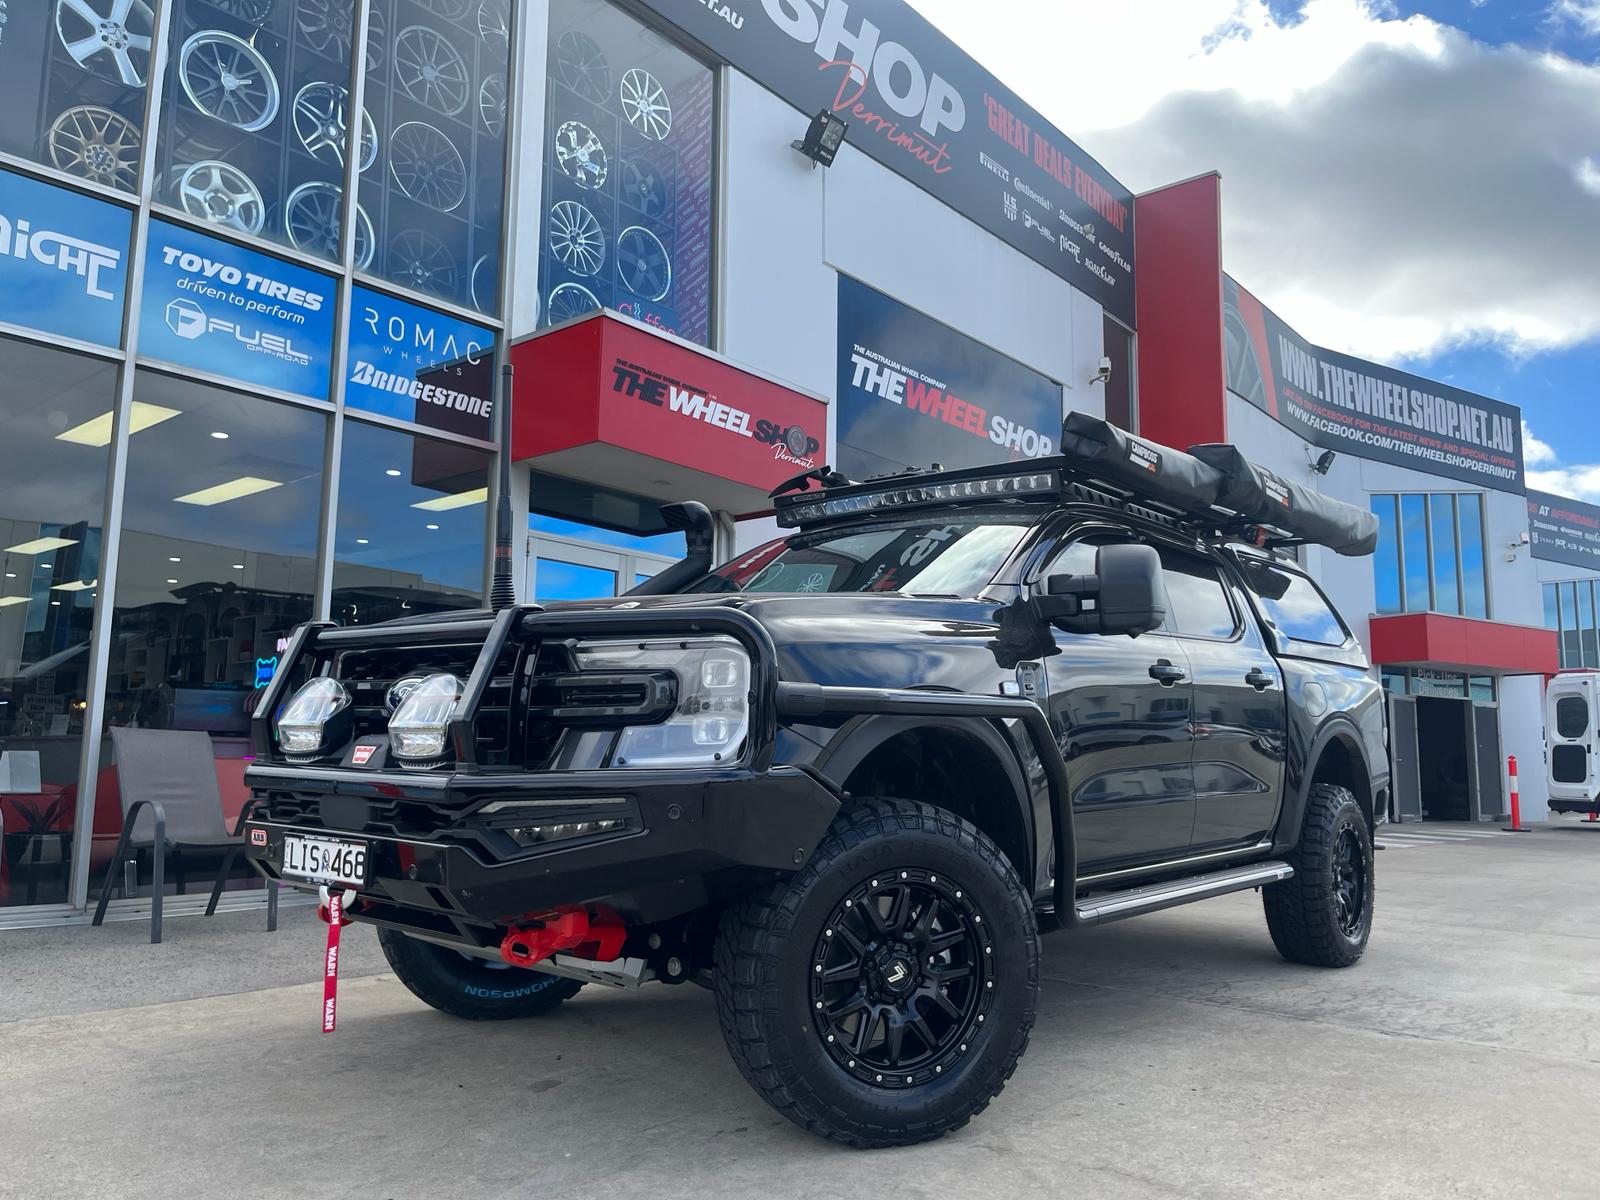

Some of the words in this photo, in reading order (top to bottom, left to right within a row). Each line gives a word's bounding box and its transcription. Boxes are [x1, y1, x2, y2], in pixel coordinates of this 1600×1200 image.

[761, 0, 967, 137] SHOP
[818, 60, 954, 175] Derrimut
[1034, 133, 1072, 190] DEALS
[162, 246, 241, 286] TOYO
[245, 272, 324, 312] TIRES
[176, 276, 229, 306] driven
[228, 290, 246, 307] to
[246, 297, 306, 326] perform
[207, 317, 309, 360] FUEL
[364, 306, 482, 367] ROMAC
[382, 344, 463, 377] WHEELS
[350, 360, 493, 419] BRIDGESTONE
[853, 343, 866, 355] THE
[865, 348, 902, 371] AUSTRALIAN
[901, 364, 920, 380] WHEEL
[919, 374, 948, 391] COMPANY
[1278, 333, 1515, 454] WWW.THEWHEELSHOP.NET.AU
[612, 365, 669, 407] THE
[668, 386, 754, 437] WHEEL
[753, 418, 821, 457] SHOP
[851, 353, 908, 405] THE
[906, 377, 989, 439] WHEEL
[988, 415, 1053, 459] SHOP
[770, 442, 815, 470] Derrimut
[1286, 400, 1517, 481] WWW.FACEBOOK.COM/THEWHEELSHOPDERRIMUT
[1312, 404, 1354, 426] FACEBOOK
[1355, 418, 1372, 430] FOR
[1373, 423, 1388, 434] THE
[1388, 427, 1419, 442] LATEST
[1419, 436, 1441, 449] NEWS
[1442, 442, 1459, 453] AND
[1460, 446, 1489, 461] SPECIAL
[1490, 455, 1516, 468] OFFERS
[330, 895, 340, 925] WARN
[327, 946, 338, 977] WARN
[324, 998, 335, 1030] WARN
